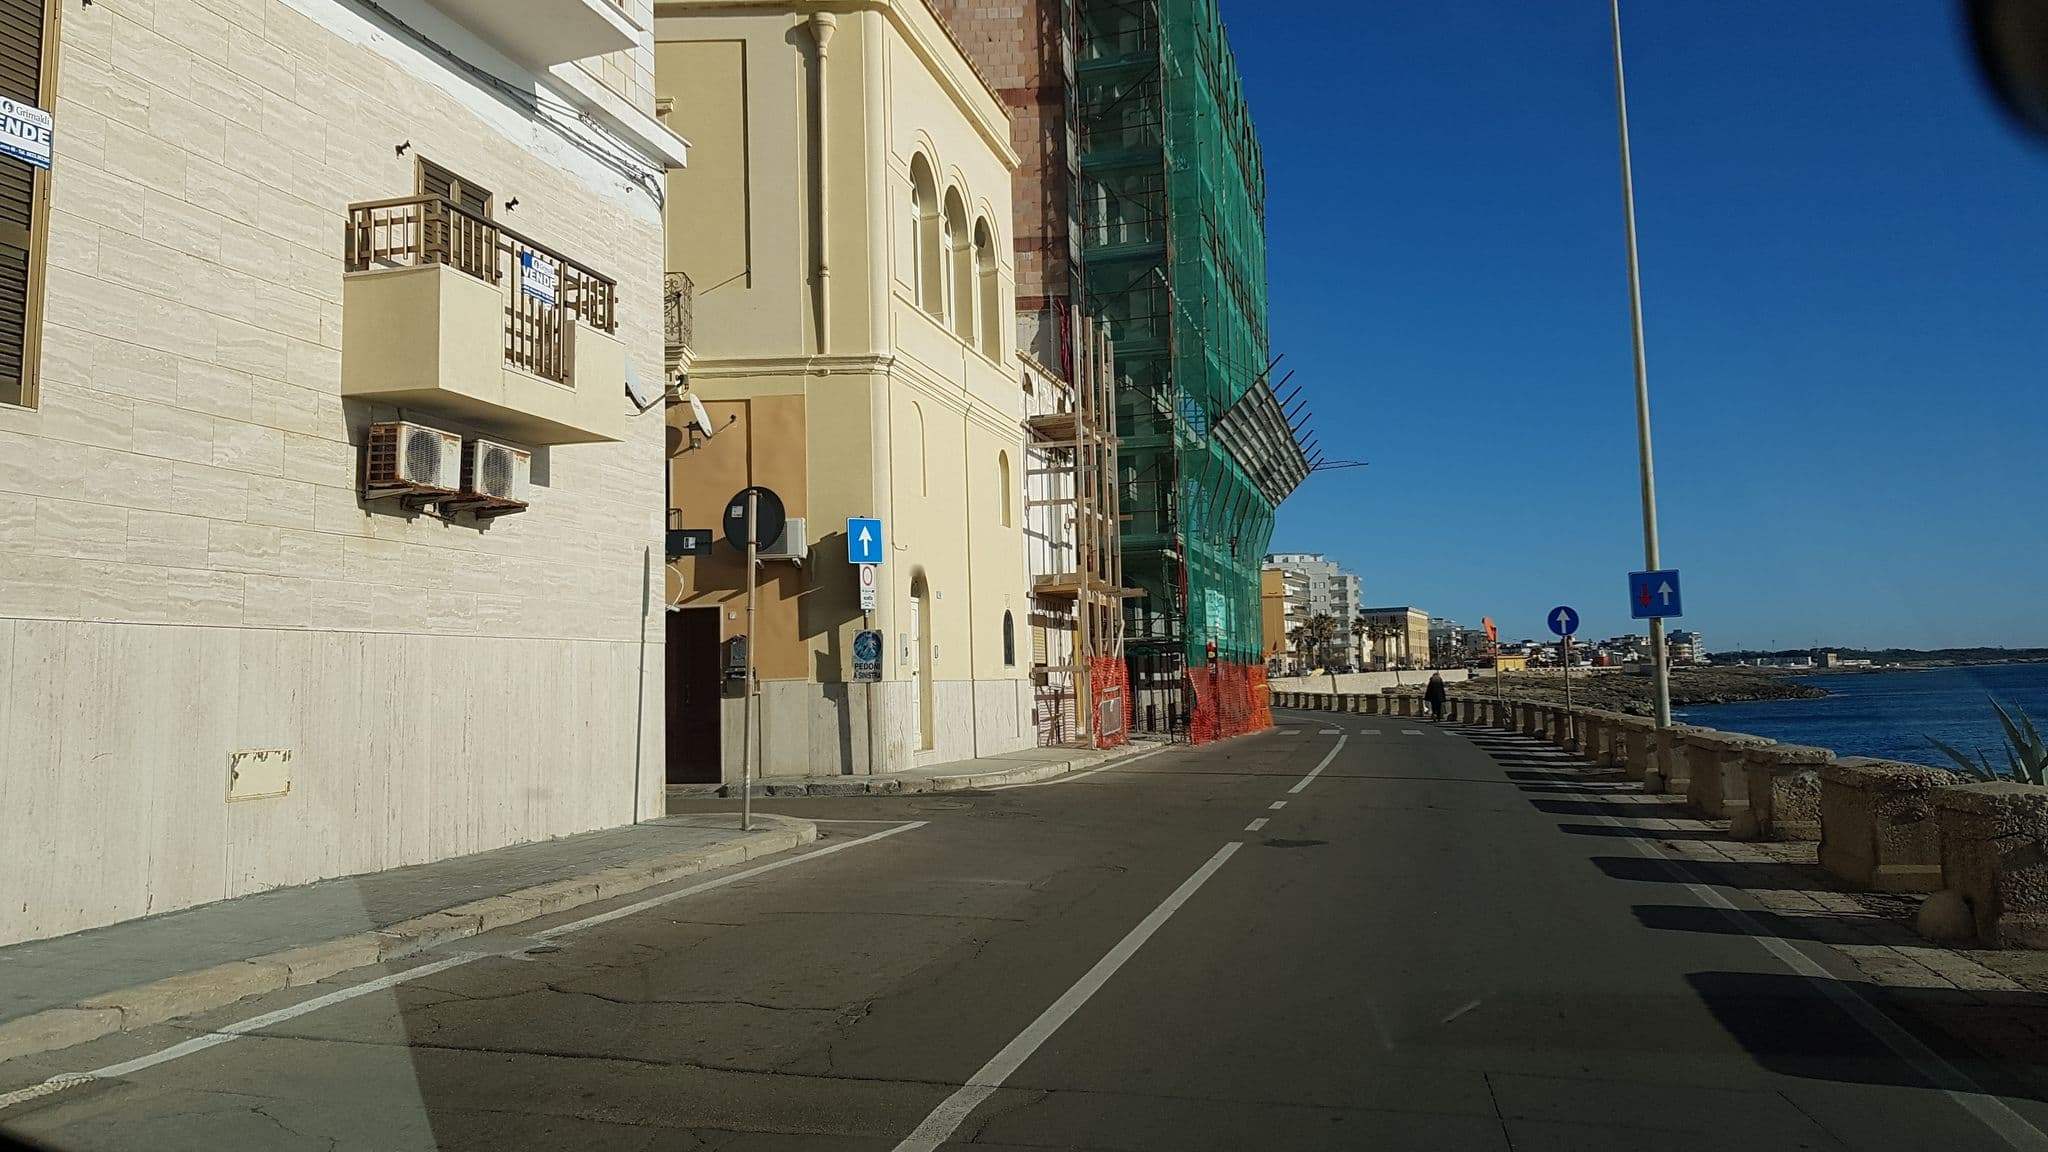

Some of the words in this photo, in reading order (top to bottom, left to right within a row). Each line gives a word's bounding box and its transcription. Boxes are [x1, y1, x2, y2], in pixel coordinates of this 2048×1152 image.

[16, 107, 50, 125] Grimaldi
[522, 266, 555, 289] VENDE
[854, 662, 881, 670] PEDONI
